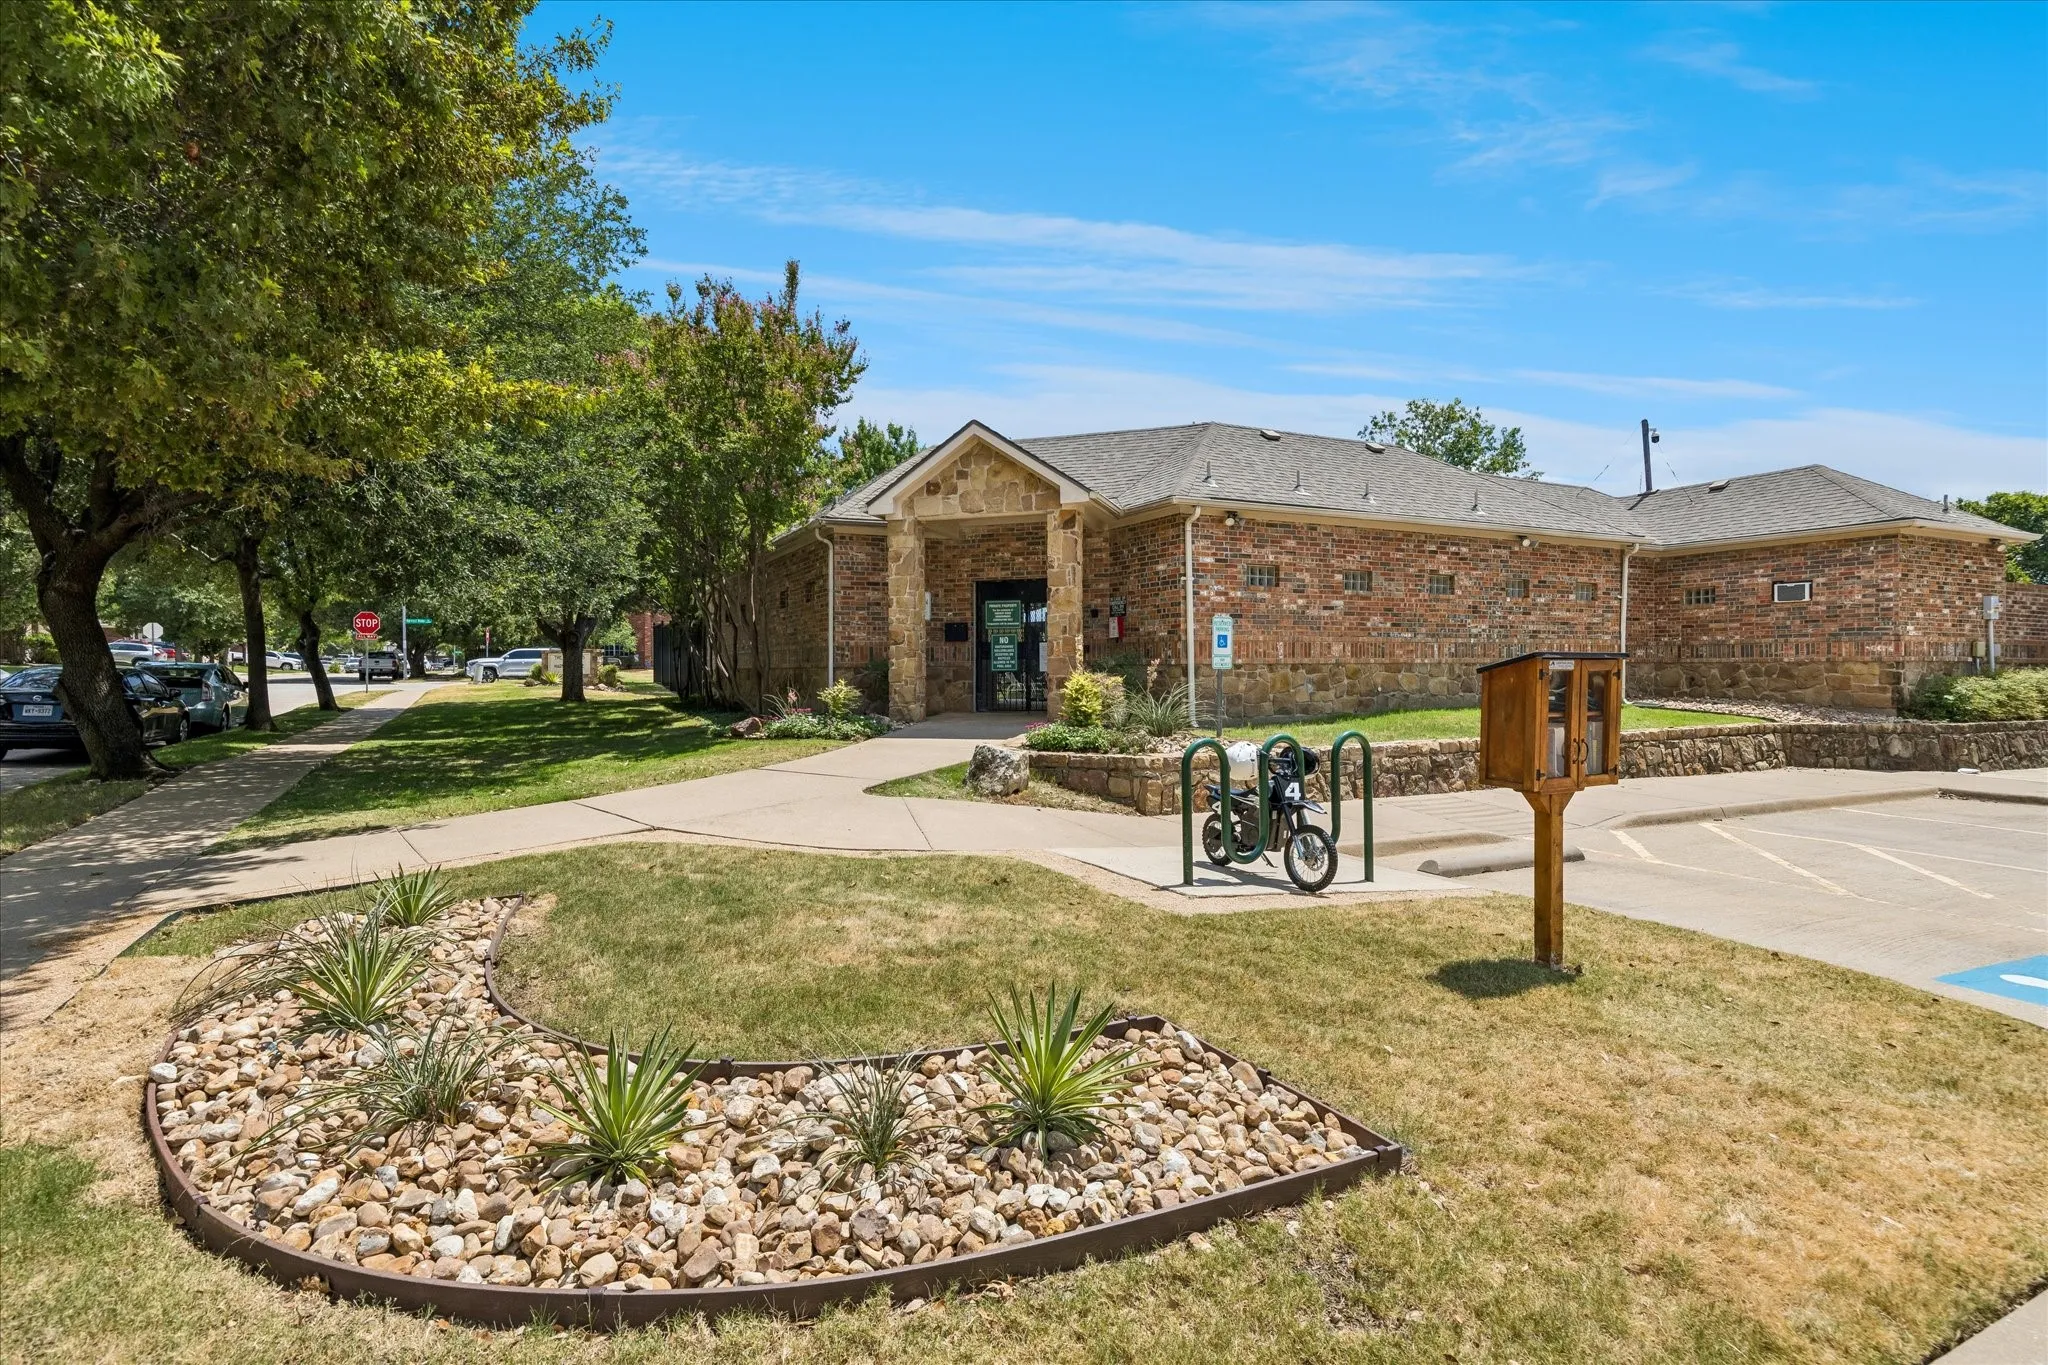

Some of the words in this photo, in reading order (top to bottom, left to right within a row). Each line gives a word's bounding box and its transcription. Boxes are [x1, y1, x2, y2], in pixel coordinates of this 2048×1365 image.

[356, 618, 378, 628] STOP
[999, 636, 1009, 644] NO
[1284, 782, 1301, 800] 4
